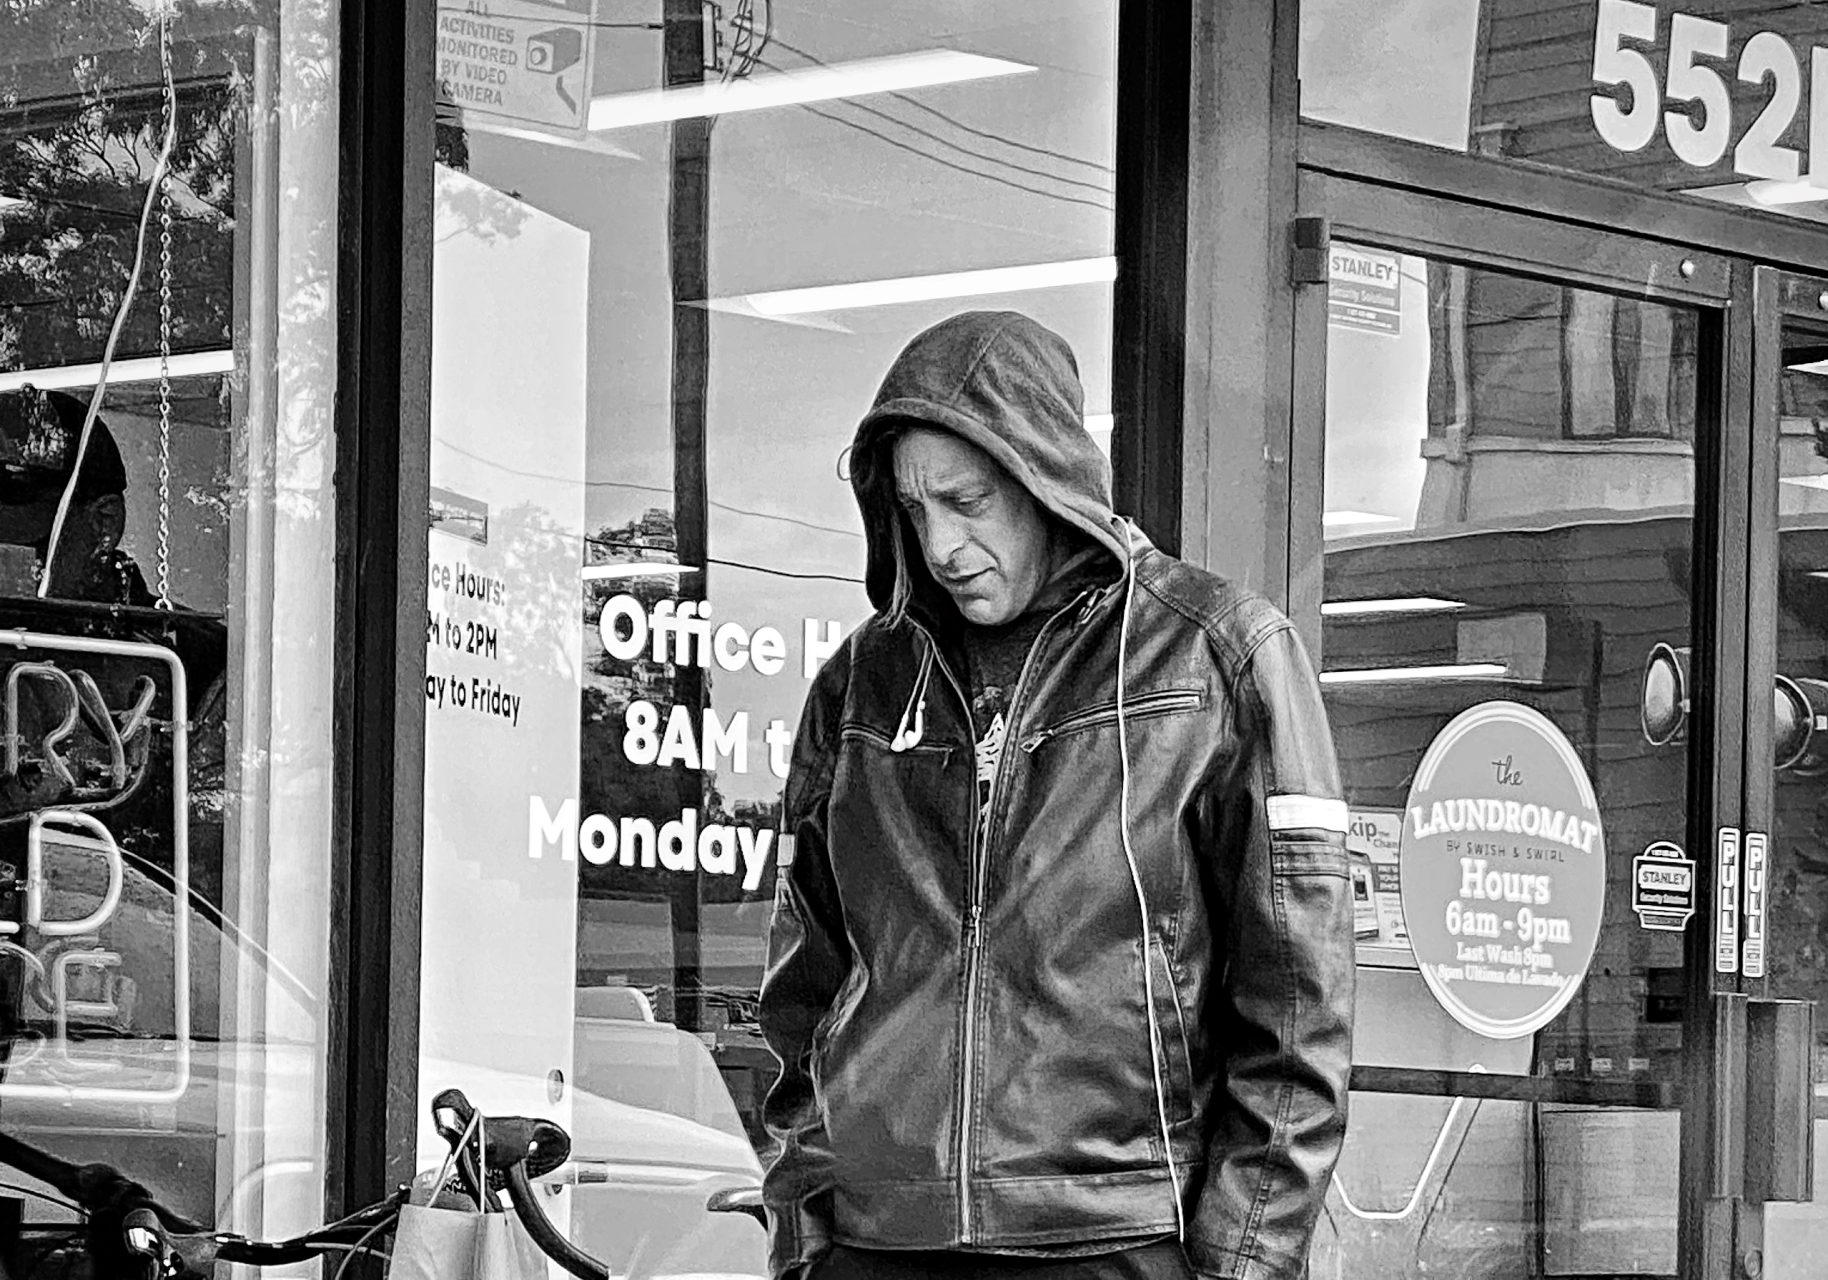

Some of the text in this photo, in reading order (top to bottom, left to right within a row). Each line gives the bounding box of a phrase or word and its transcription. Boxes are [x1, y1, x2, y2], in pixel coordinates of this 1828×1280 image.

[466, 0, 489, 16] ALL
[437, 37, 518, 66] MONITORED
[439, 16, 514, 44] ACTIVITIES
[441, 58, 507, 85] BY VIDEO
[442, 80, 503, 106] CAMERA
[1331, 256, 1393, 281] STANLEY
[456, 562, 506, 606] Hours:
[446, 617, 461, 650] to
[466, 620, 498, 660] 2PM
[600, 594, 786, 676] Office
[450, 674, 467, 707] to
[471, 677, 521, 727] Friday
[623, 700, 749, 774] 8AM
[1491, 755, 1523, 786] the
[528, 795, 774, 891] Monday
[1410, 798, 1597, 854] LAUNDROMAT
[1447, 840, 1461, 851] BY
[1467, 842, 1505, 857] SWISH
[1526, 848, 1565, 862] SWIRL
[1459, 857, 1551, 905] Hours
[1642, 871, 1687, 886] STANLEY
[1721, 841, 1736, 934] PULL
[1748, 847, 1763, 939] PULL
[1446, 900, 1500, 938] 6am
[1517, 907, 1572, 953] 9pm
[1456, 941, 1554, 972] Last Wash 8pm
